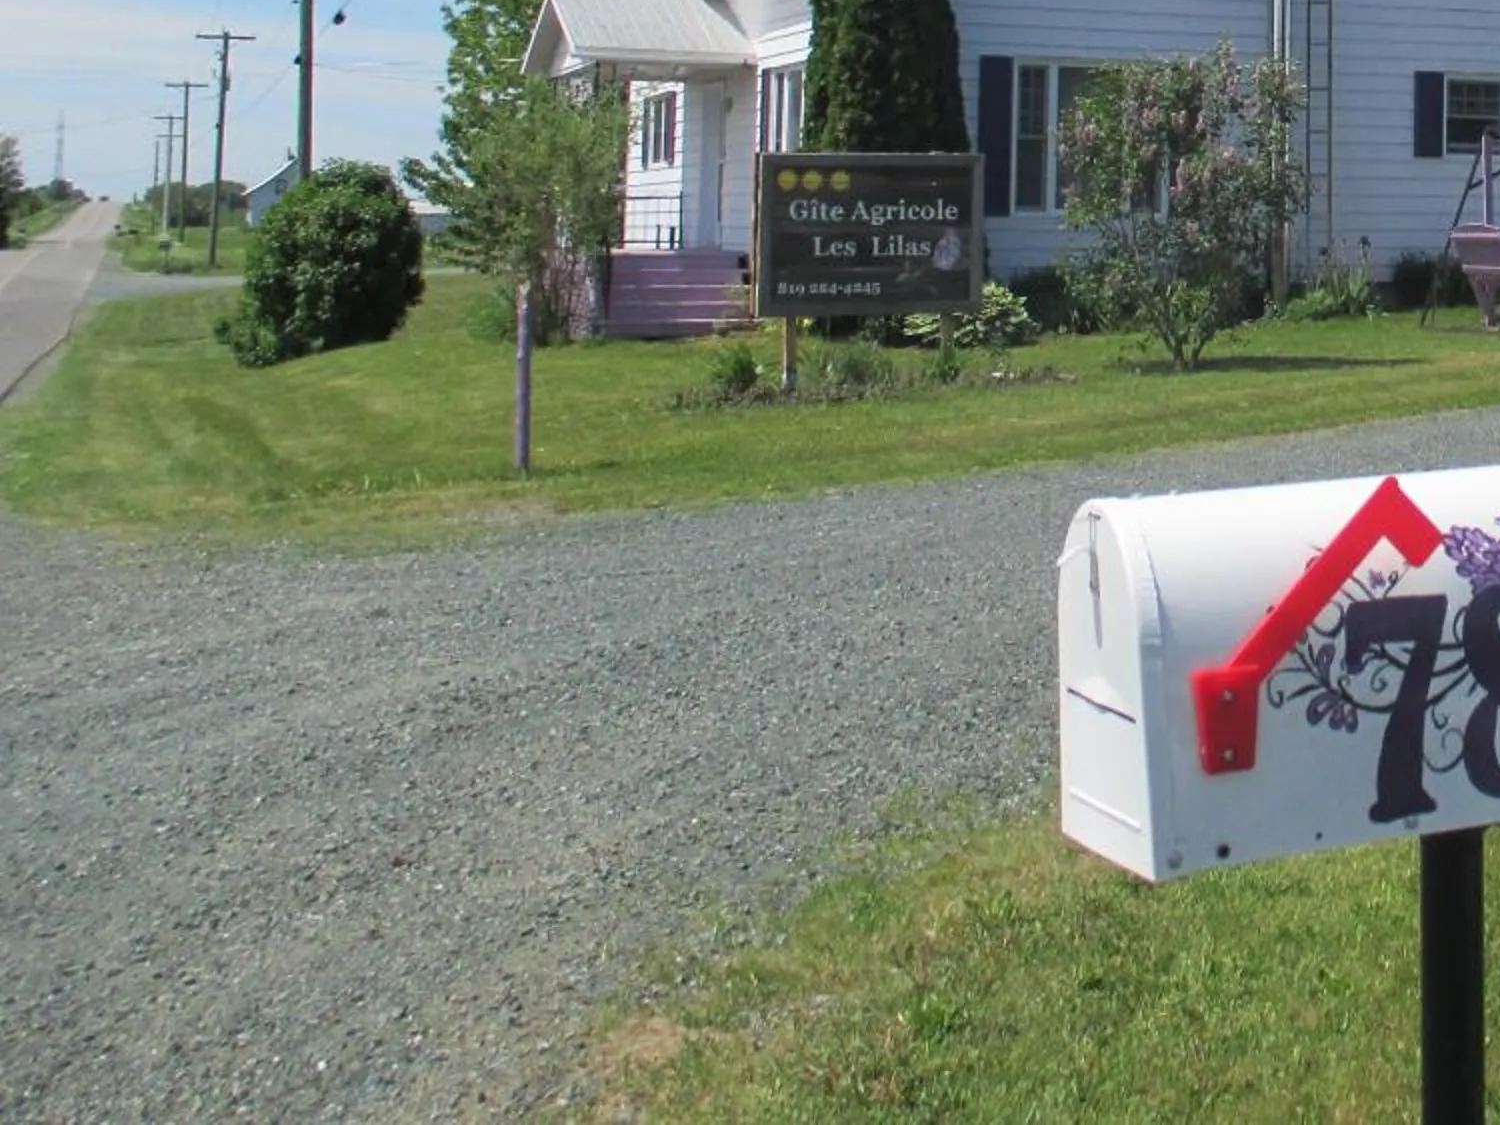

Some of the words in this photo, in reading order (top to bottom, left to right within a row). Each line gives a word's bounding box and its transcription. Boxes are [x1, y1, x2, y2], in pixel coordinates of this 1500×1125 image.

[789, 198, 844, 221] Gîte
[852, 198, 959, 226] Agricole
[813, 236, 857, 257] Les
[872, 235, 932, 257] Lilas
